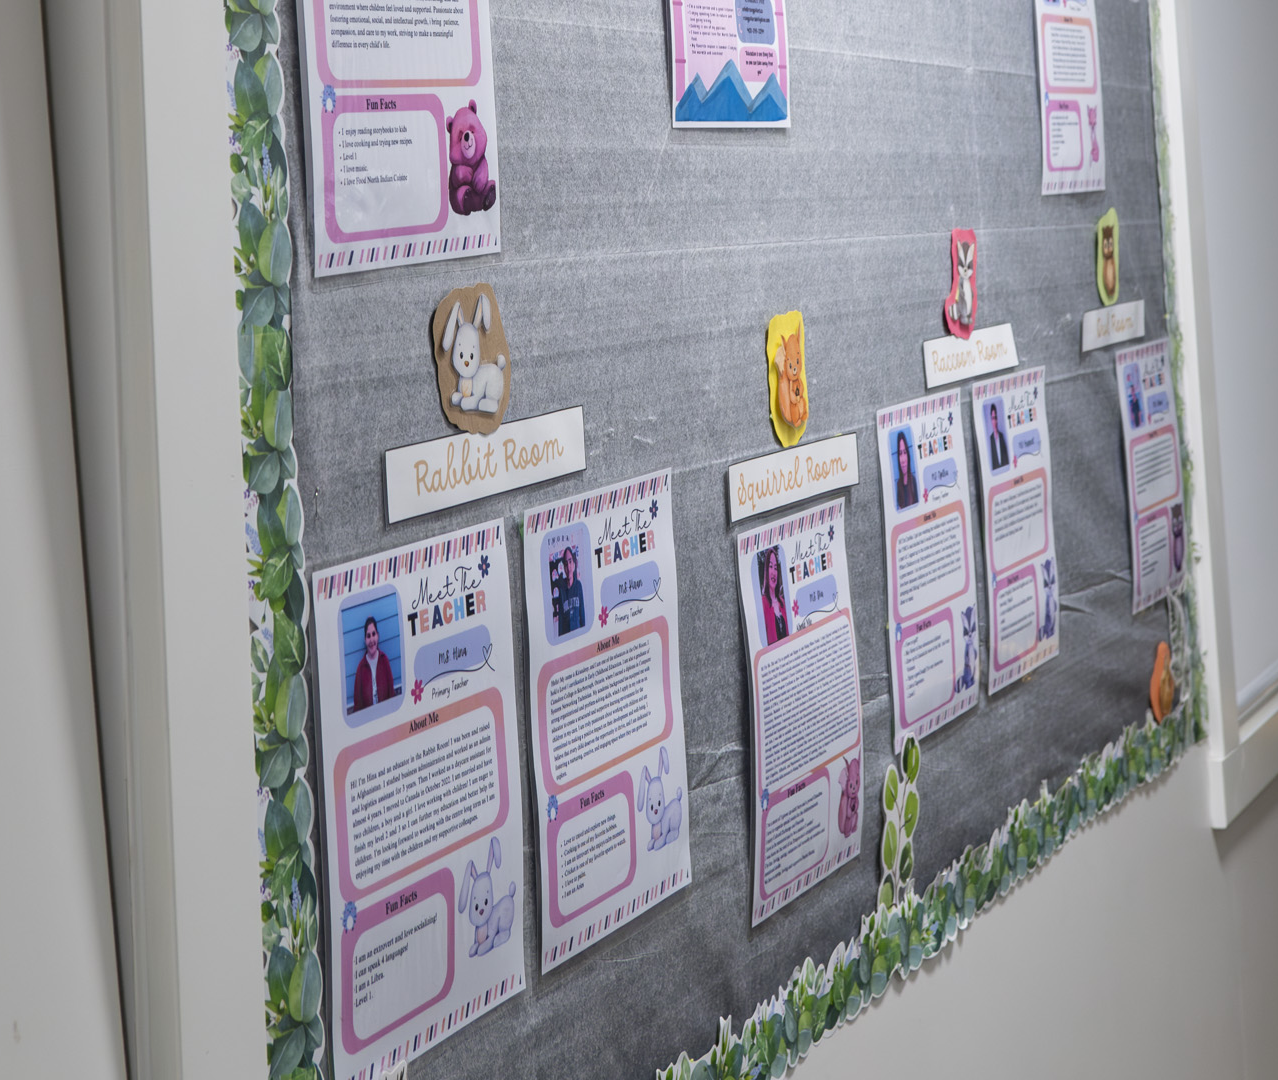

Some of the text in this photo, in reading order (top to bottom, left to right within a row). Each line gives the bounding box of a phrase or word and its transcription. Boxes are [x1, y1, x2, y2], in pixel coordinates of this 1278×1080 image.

[366, 98, 396, 110] Fun Facts
[932, 340, 1008, 373] Raccoon Room
[1007, 407, 1037, 429] TEACHER
[918, 434, 953, 459] TEACHER
[414, 438, 564, 496] Rabbit Room
[737, 456, 847, 511] Squirrel Room
[598, 517, 631, 545] Meet
[631, 508, 651, 531] The
[594, 529, 655, 569] TEACHER
[791, 540, 814, 564] Meet
[789, 552, 833, 584] TEACHER
[412, 565, 481, 610] Meet The
[407, 589, 487, 637] TEACHER
[629, 606, 643, 618] Teacher
[596, 635, 620, 653] About Me
[431, 678, 469, 699] Primary Teacher
[409, 712, 439, 733] About Me
[580, 788, 605, 809] Fun Facts
[385, 890, 417, 915] Fun Facts
